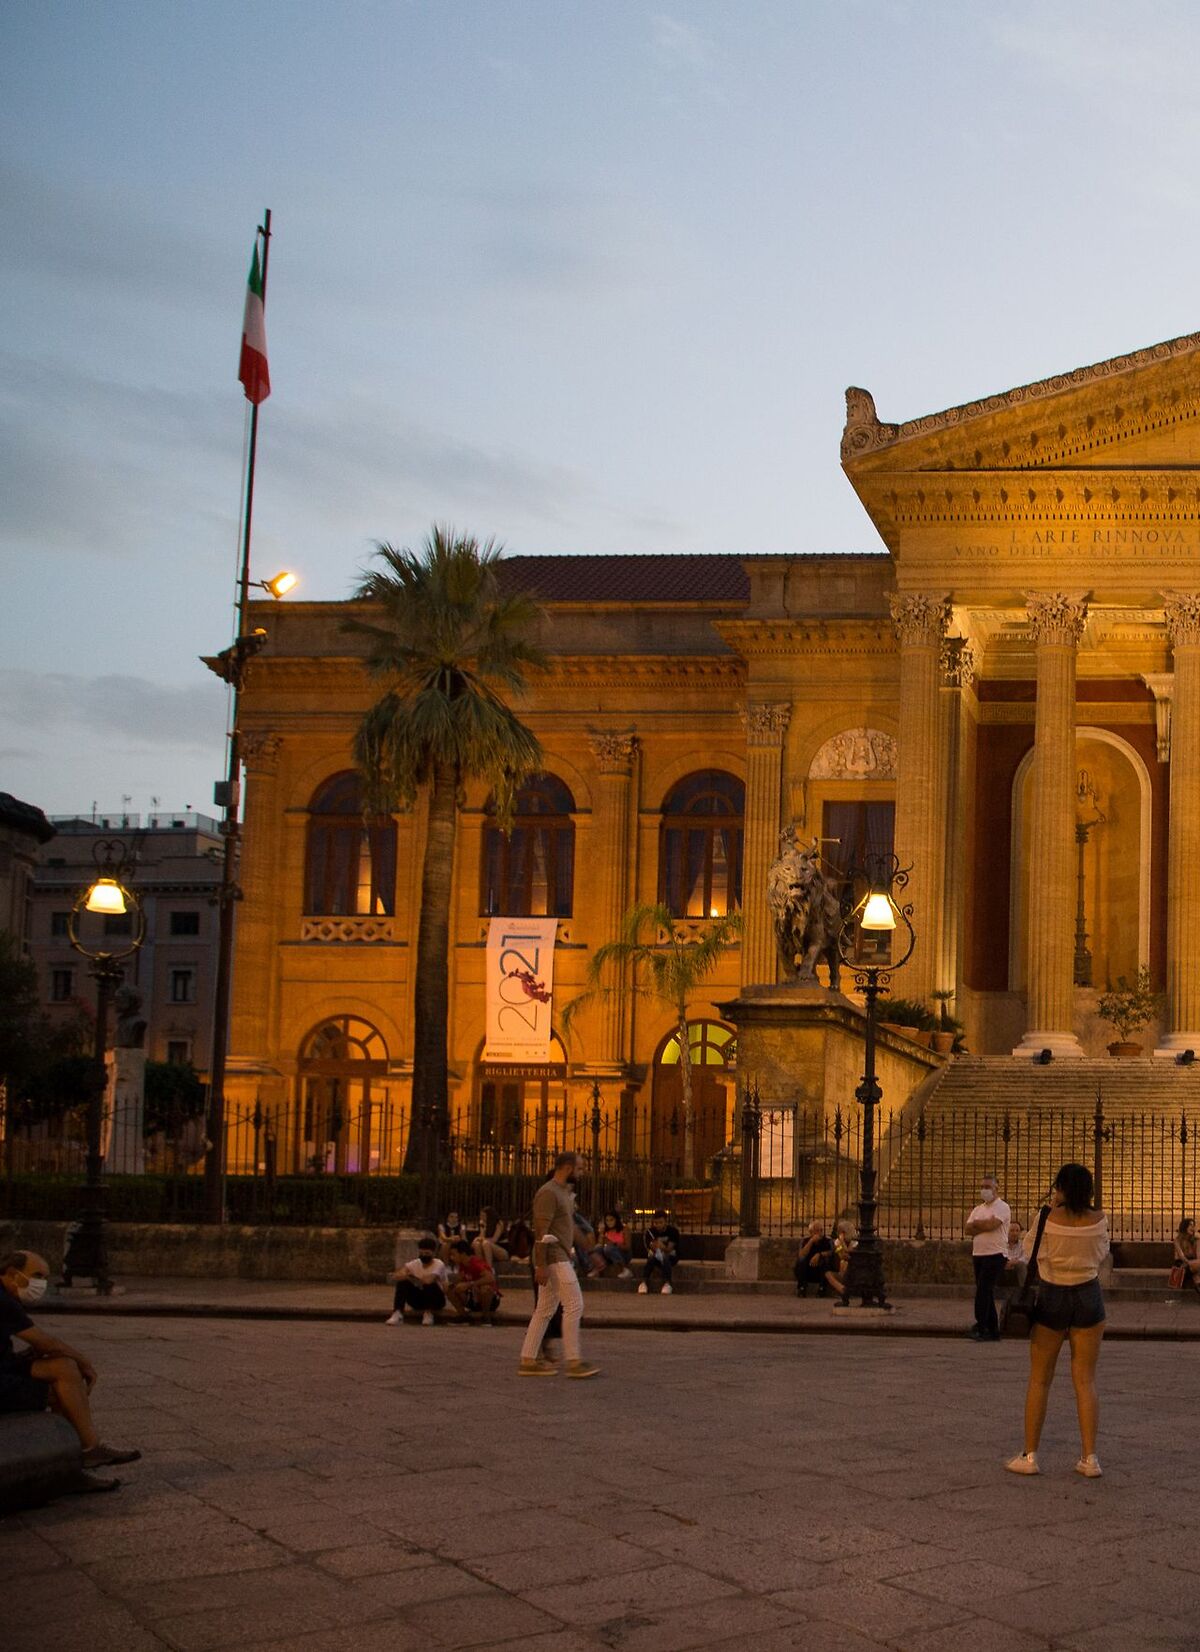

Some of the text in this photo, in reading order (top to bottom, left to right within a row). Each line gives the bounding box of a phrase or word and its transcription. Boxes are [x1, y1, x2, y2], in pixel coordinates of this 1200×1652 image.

[1012, 530, 1081, 544] L'ARTE
[1093, 530, 1186, 544] RINNOVA
[953, 545, 1000, 556] VANO
[1064, 545, 1121, 556] SCENE
[498, 935, 542, 1032] 2021
[485, 1067, 557, 1076] BIGLIETTERIA
